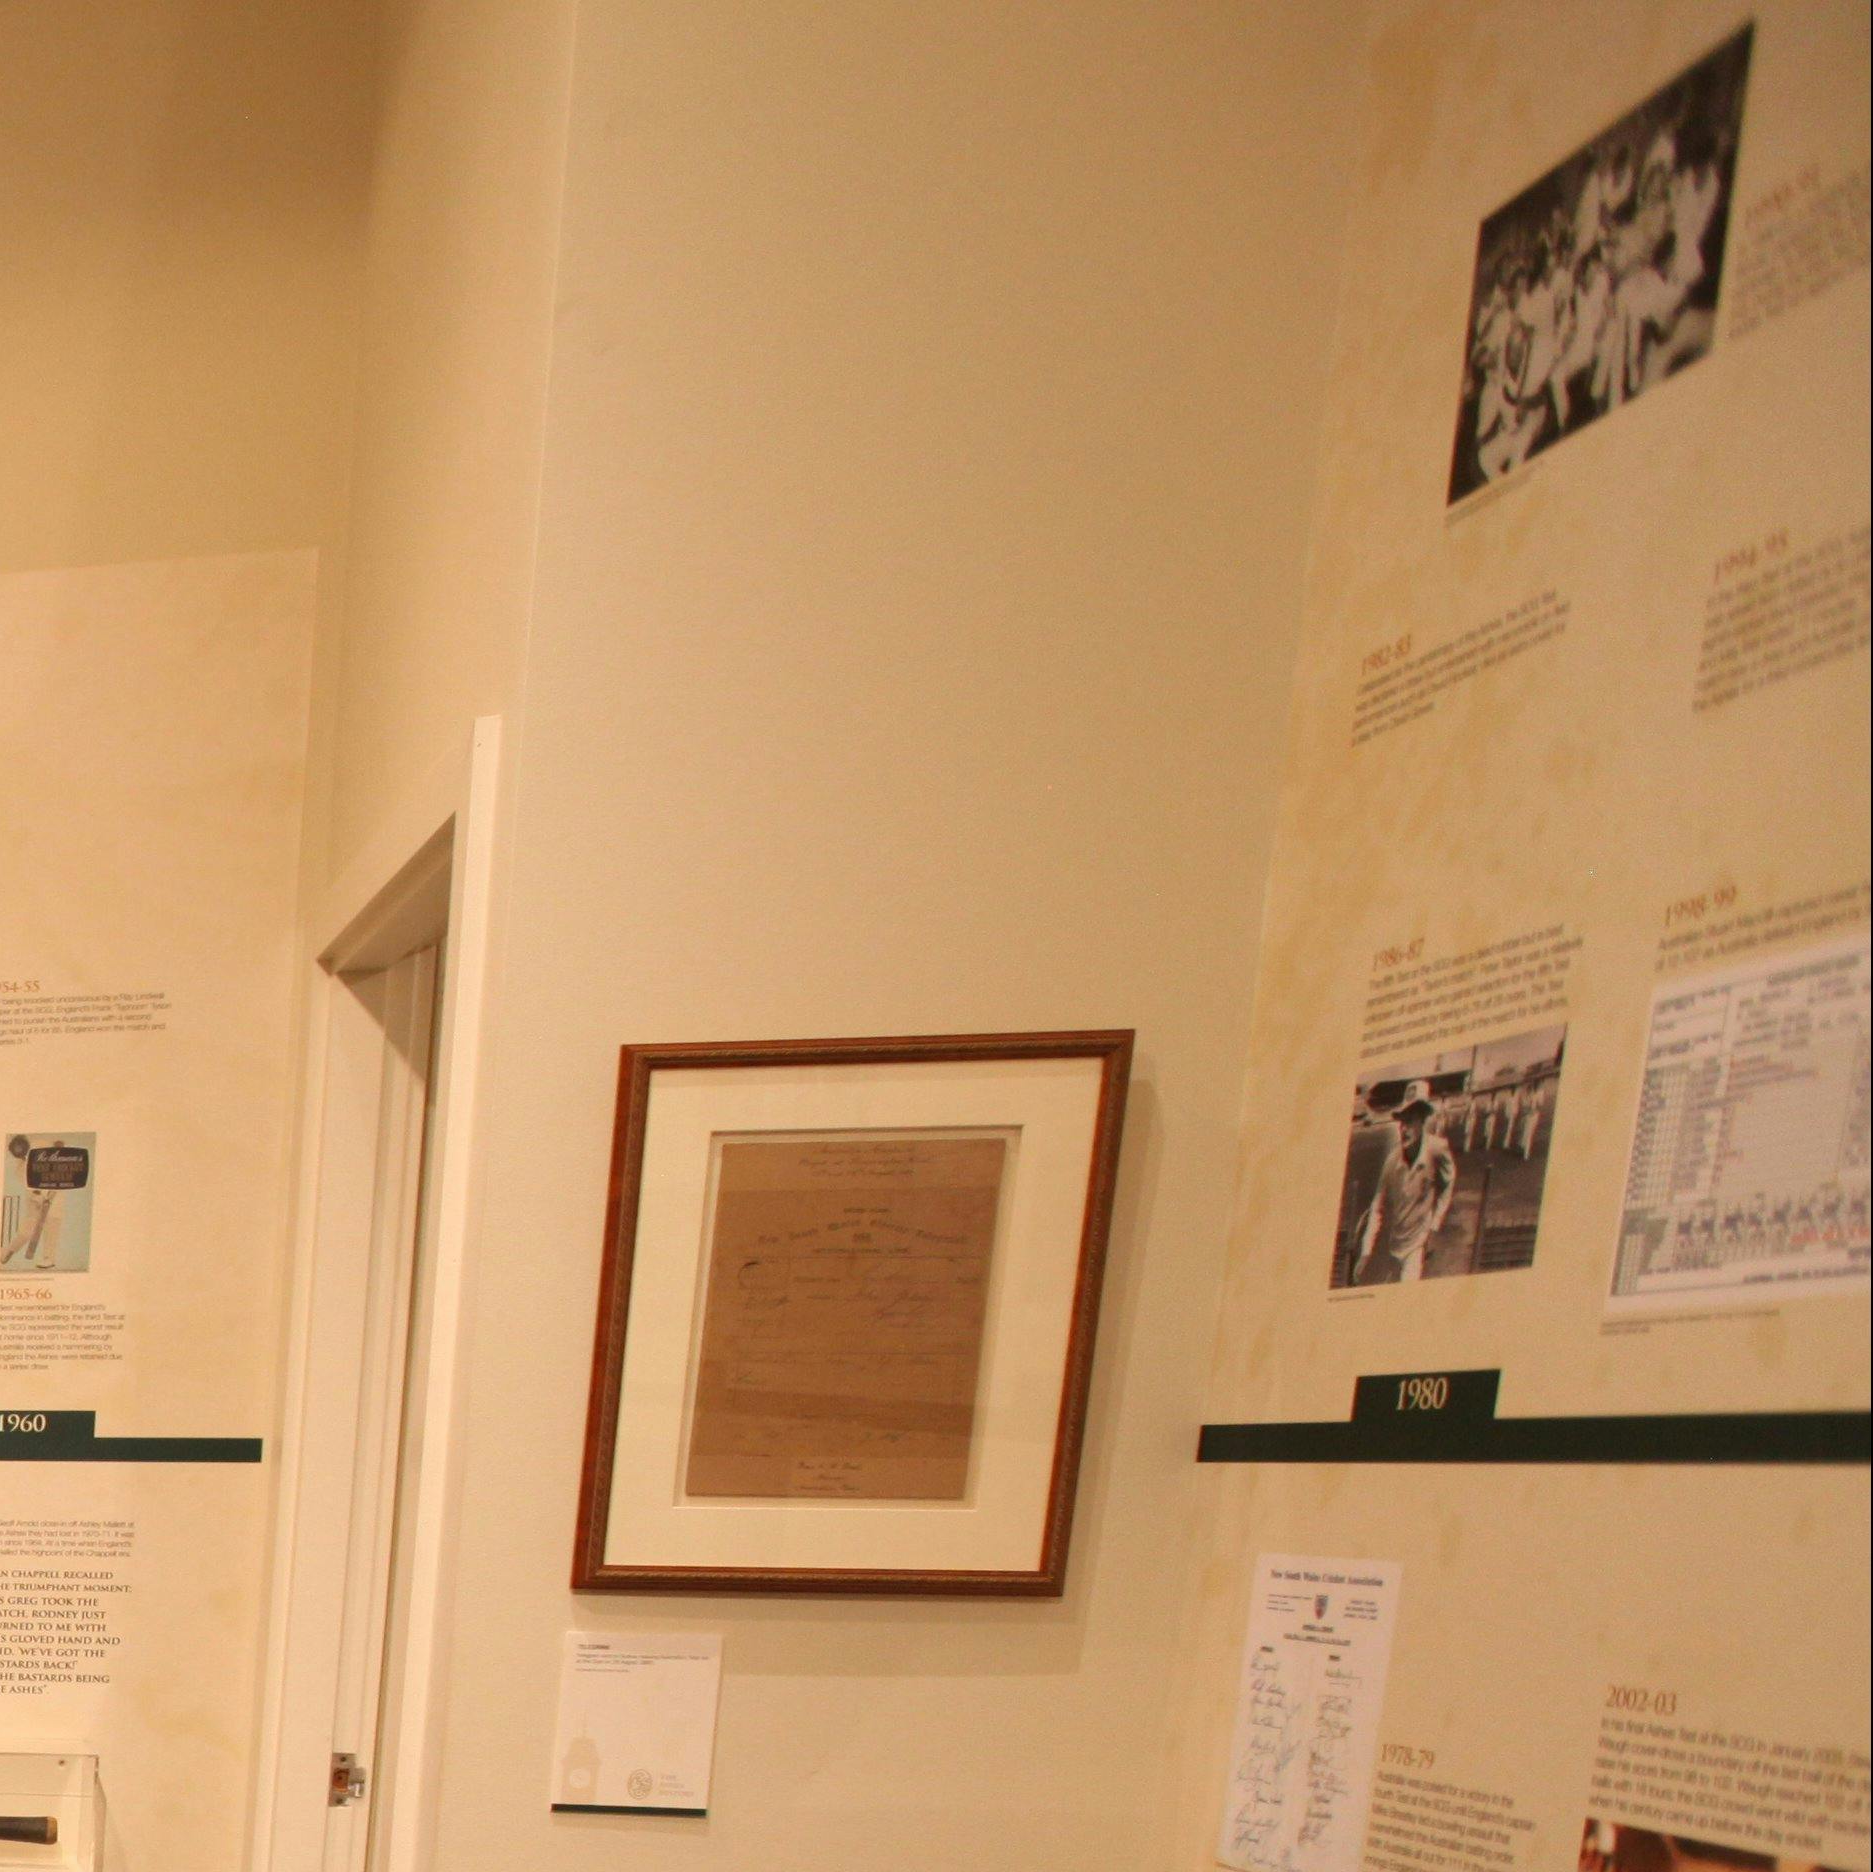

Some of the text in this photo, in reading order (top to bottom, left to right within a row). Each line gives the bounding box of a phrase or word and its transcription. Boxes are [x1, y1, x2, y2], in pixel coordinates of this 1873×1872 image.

[0, 1288, 52, 1300] 1965-66
[1396, 1376, 1448, 1411] 1980
[11, 1570, 61, 1579] CHAPPELL
[63, 1571, 113, 1580] RECALLED
[13, 1584, 80, 1592] TRIUMPHANT
[83, 1585, 132, 1593] MOMENT:
[7, 1597, 38, 1606] GREG
[41, 1597, 74, 1606] TOOK
[77, 1598, 99, 1606] THE
[31, 1610, 78, 1619] RODNEY
[81, 1611, 106, 1620] JUST
[38, 1623, 52, 1631] TO
[55, 1623, 71, 1632] ME
[75, 1623, 106, 1632] WITH
[9, 1635, 54, 1644] GLOVED
[57, 1636, 92, 1645] HAND
[95, 1637, 121, 1646] AND
[55, 1649, 80, 1658] GOT
[84, 1649, 105, 1658] THE
[18, 1673, 72, 1683] BASTARDS
[75, 1674, 110, 1684] BEING
[1605, 1685, 1678, 1715] 2002-03
[1379, 1742, 1436, 1770] 1978-79
